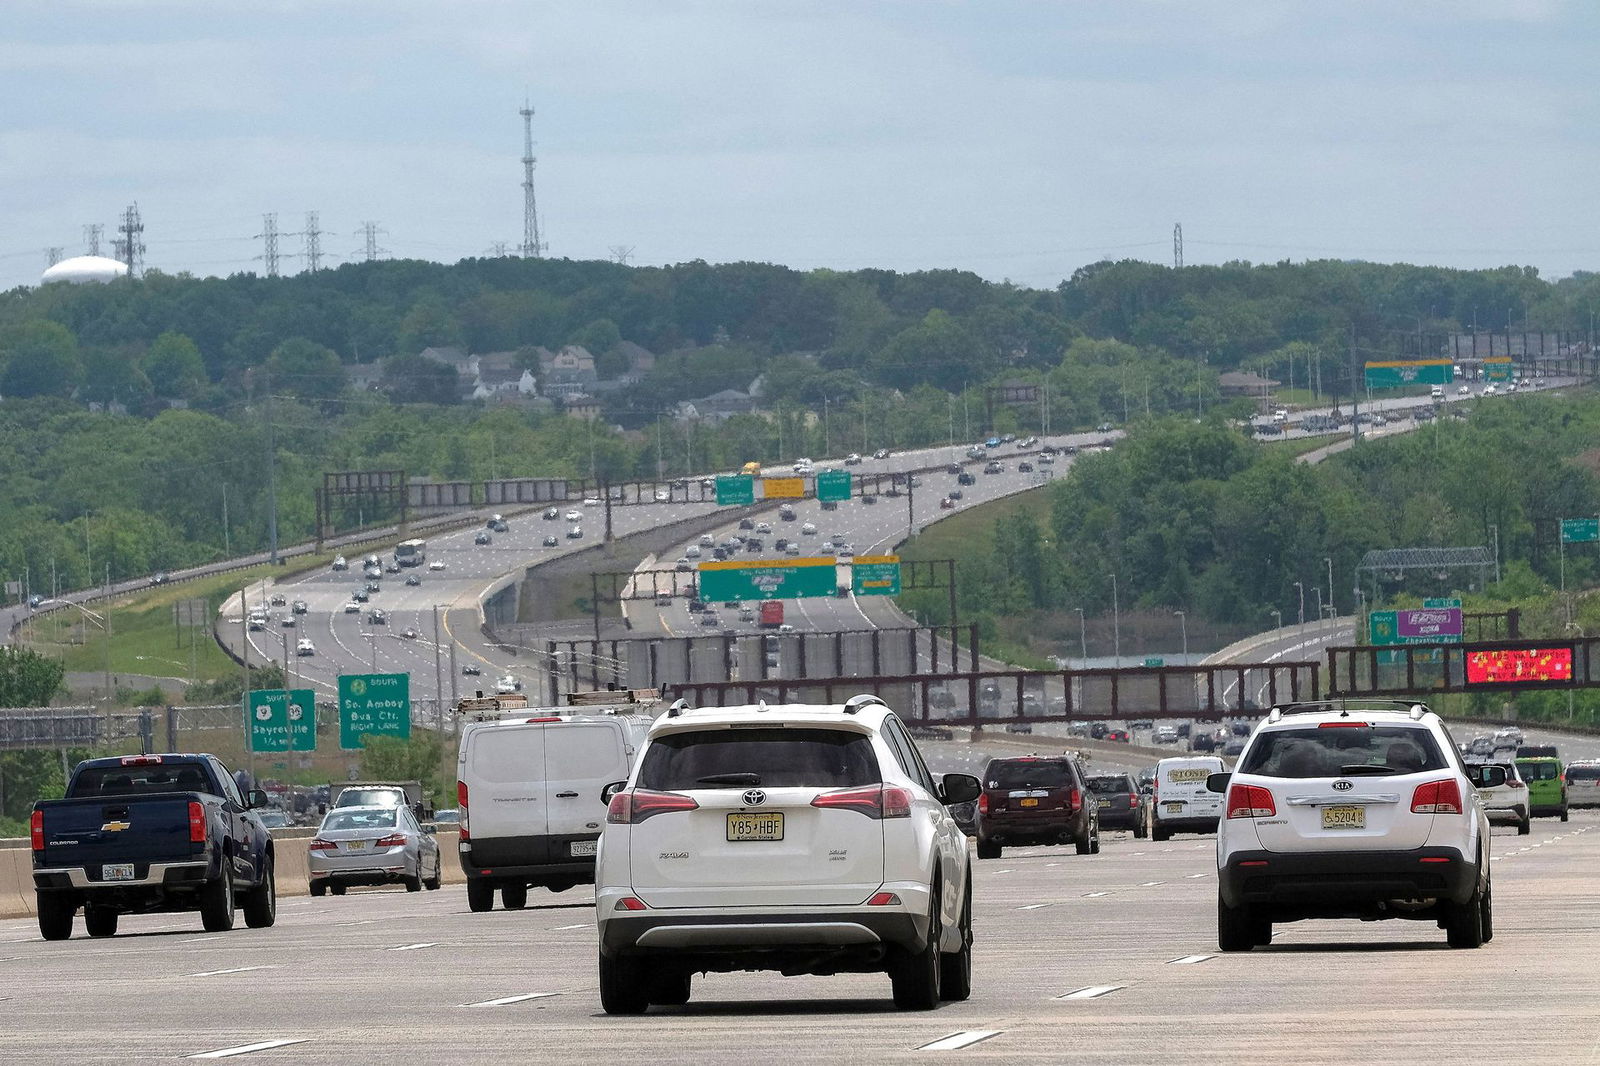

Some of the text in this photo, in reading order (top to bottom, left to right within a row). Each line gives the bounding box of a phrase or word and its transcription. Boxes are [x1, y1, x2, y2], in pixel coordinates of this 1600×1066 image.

[371, 678, 398, 686] SOUTH
[345, 699, 404, 709] So. Amboy
[1335, 782, 1351, 790] KIA
[1334, 812, 1356, 823] 5204
